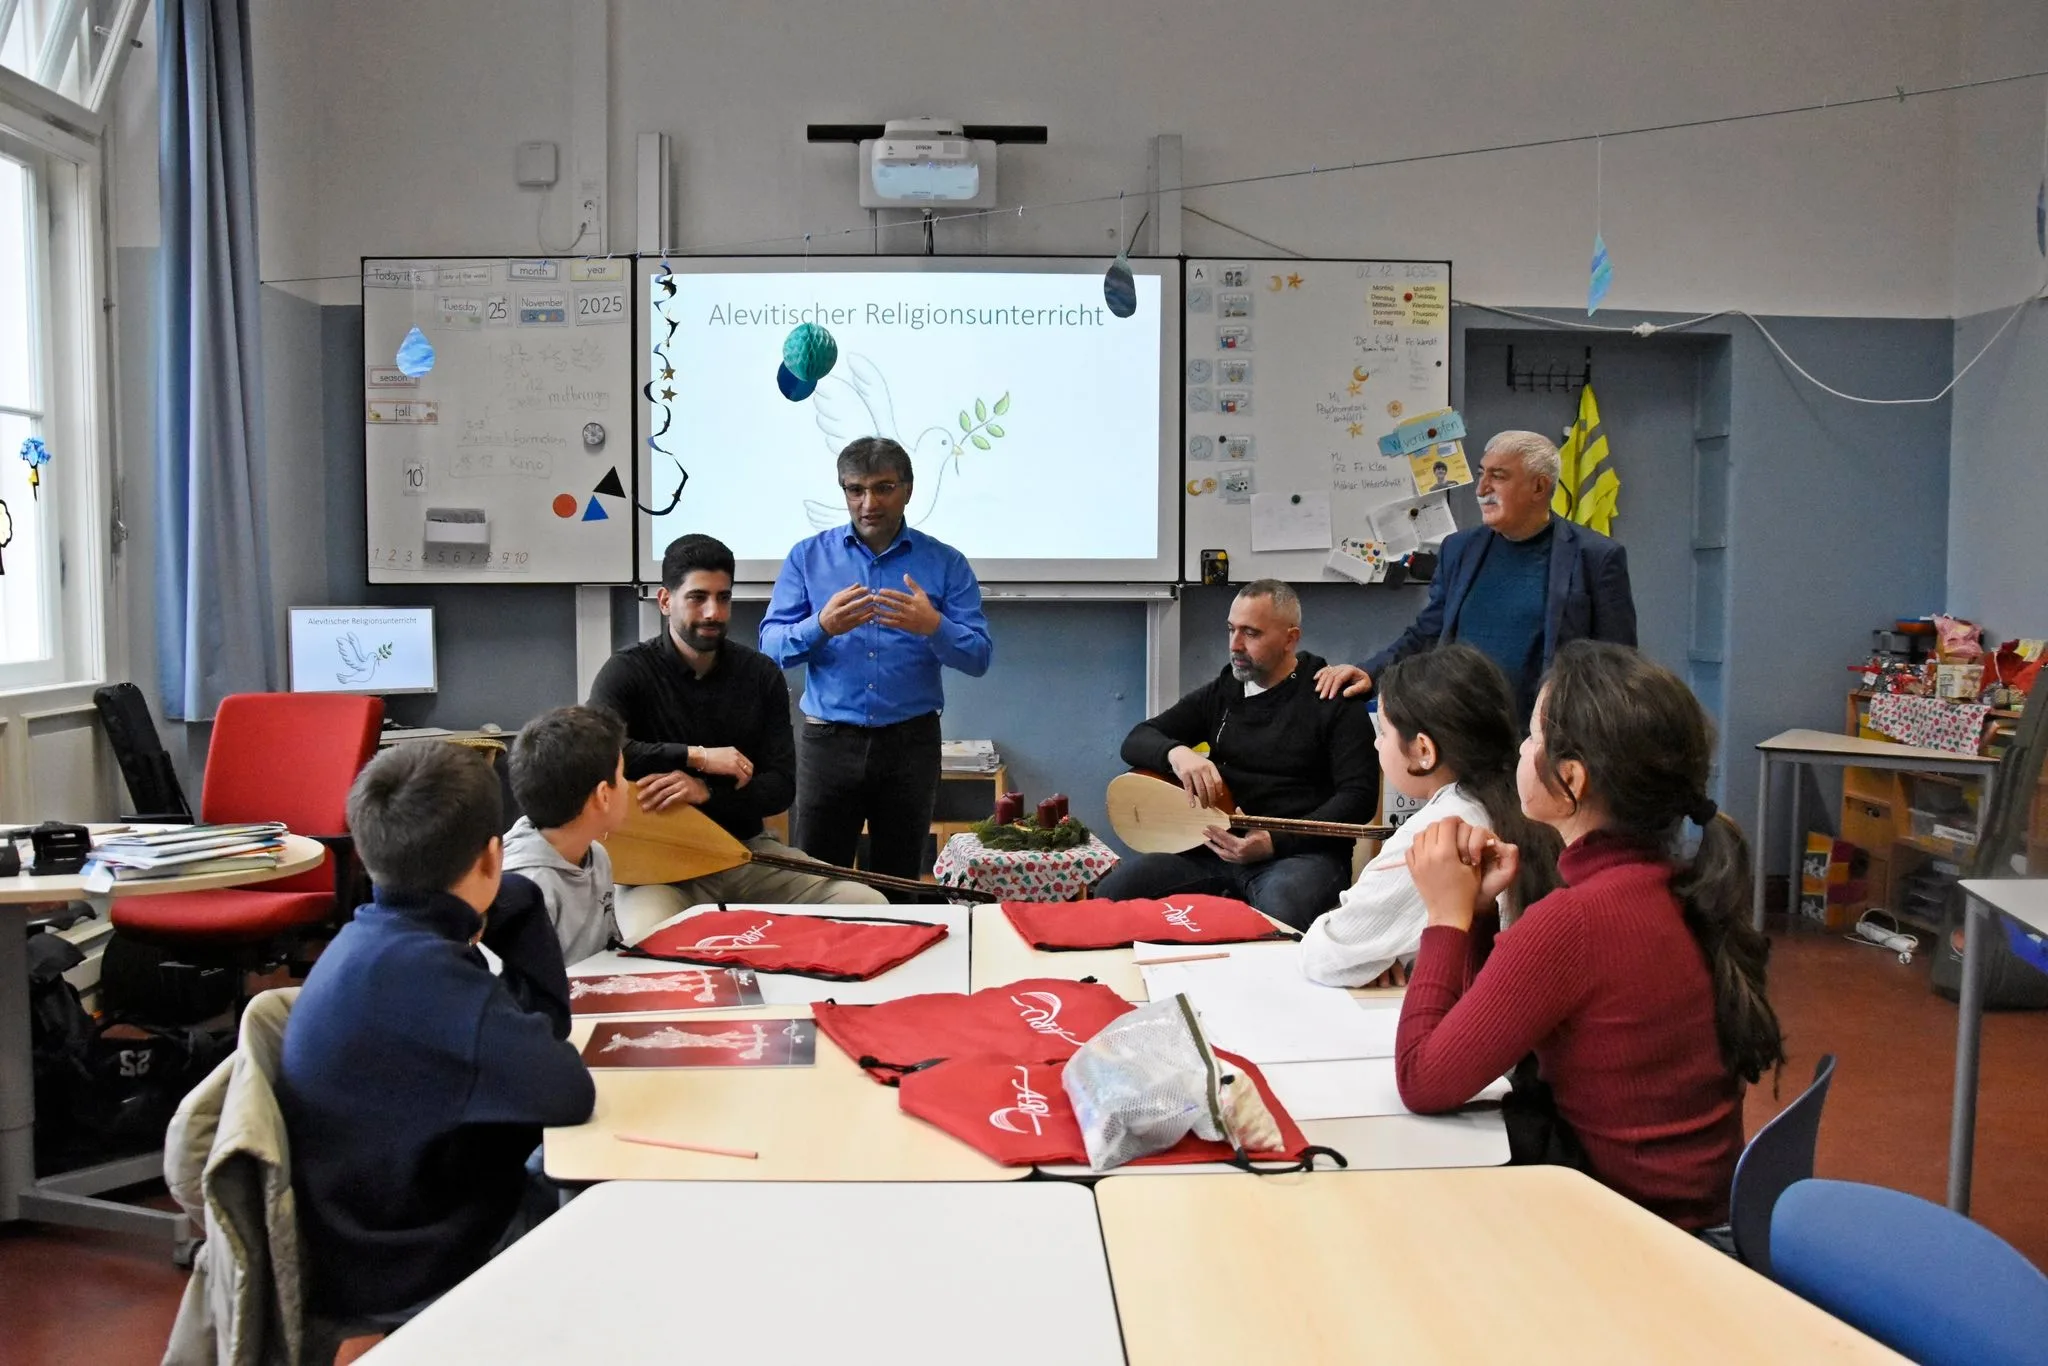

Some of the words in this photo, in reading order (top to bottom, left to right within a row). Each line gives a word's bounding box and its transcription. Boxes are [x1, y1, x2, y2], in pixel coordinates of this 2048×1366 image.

[374, 269, 401, 285] Today
[519, 264, 548, 276] month
[587, 266, 606, 278] year
[1195, 268, 1204, 280] A
[442, 299, 478, 315] Tuesday
[521, 297, 563, 308] November
[580, 296, 622, 315] 2025
[709, 303, 856, 326] Alevitischer
[866, 301, 1104, 331] Religionsunterricht
[395, 404, 411, 422] fall
[388, 549, 397, 561] 2
[406, 550, 412, 562] 3
[421, 550, 428, 561] 4
[438, 550, 445, 561] 5
[453, 550, 460, 562] 6
[502, 552, 510, 563] 9
[514, 552, 529, 564] 10
[307, 617, 350, 626] Alevitischer
[351, 617, 417, 627] Religionsunterricht
